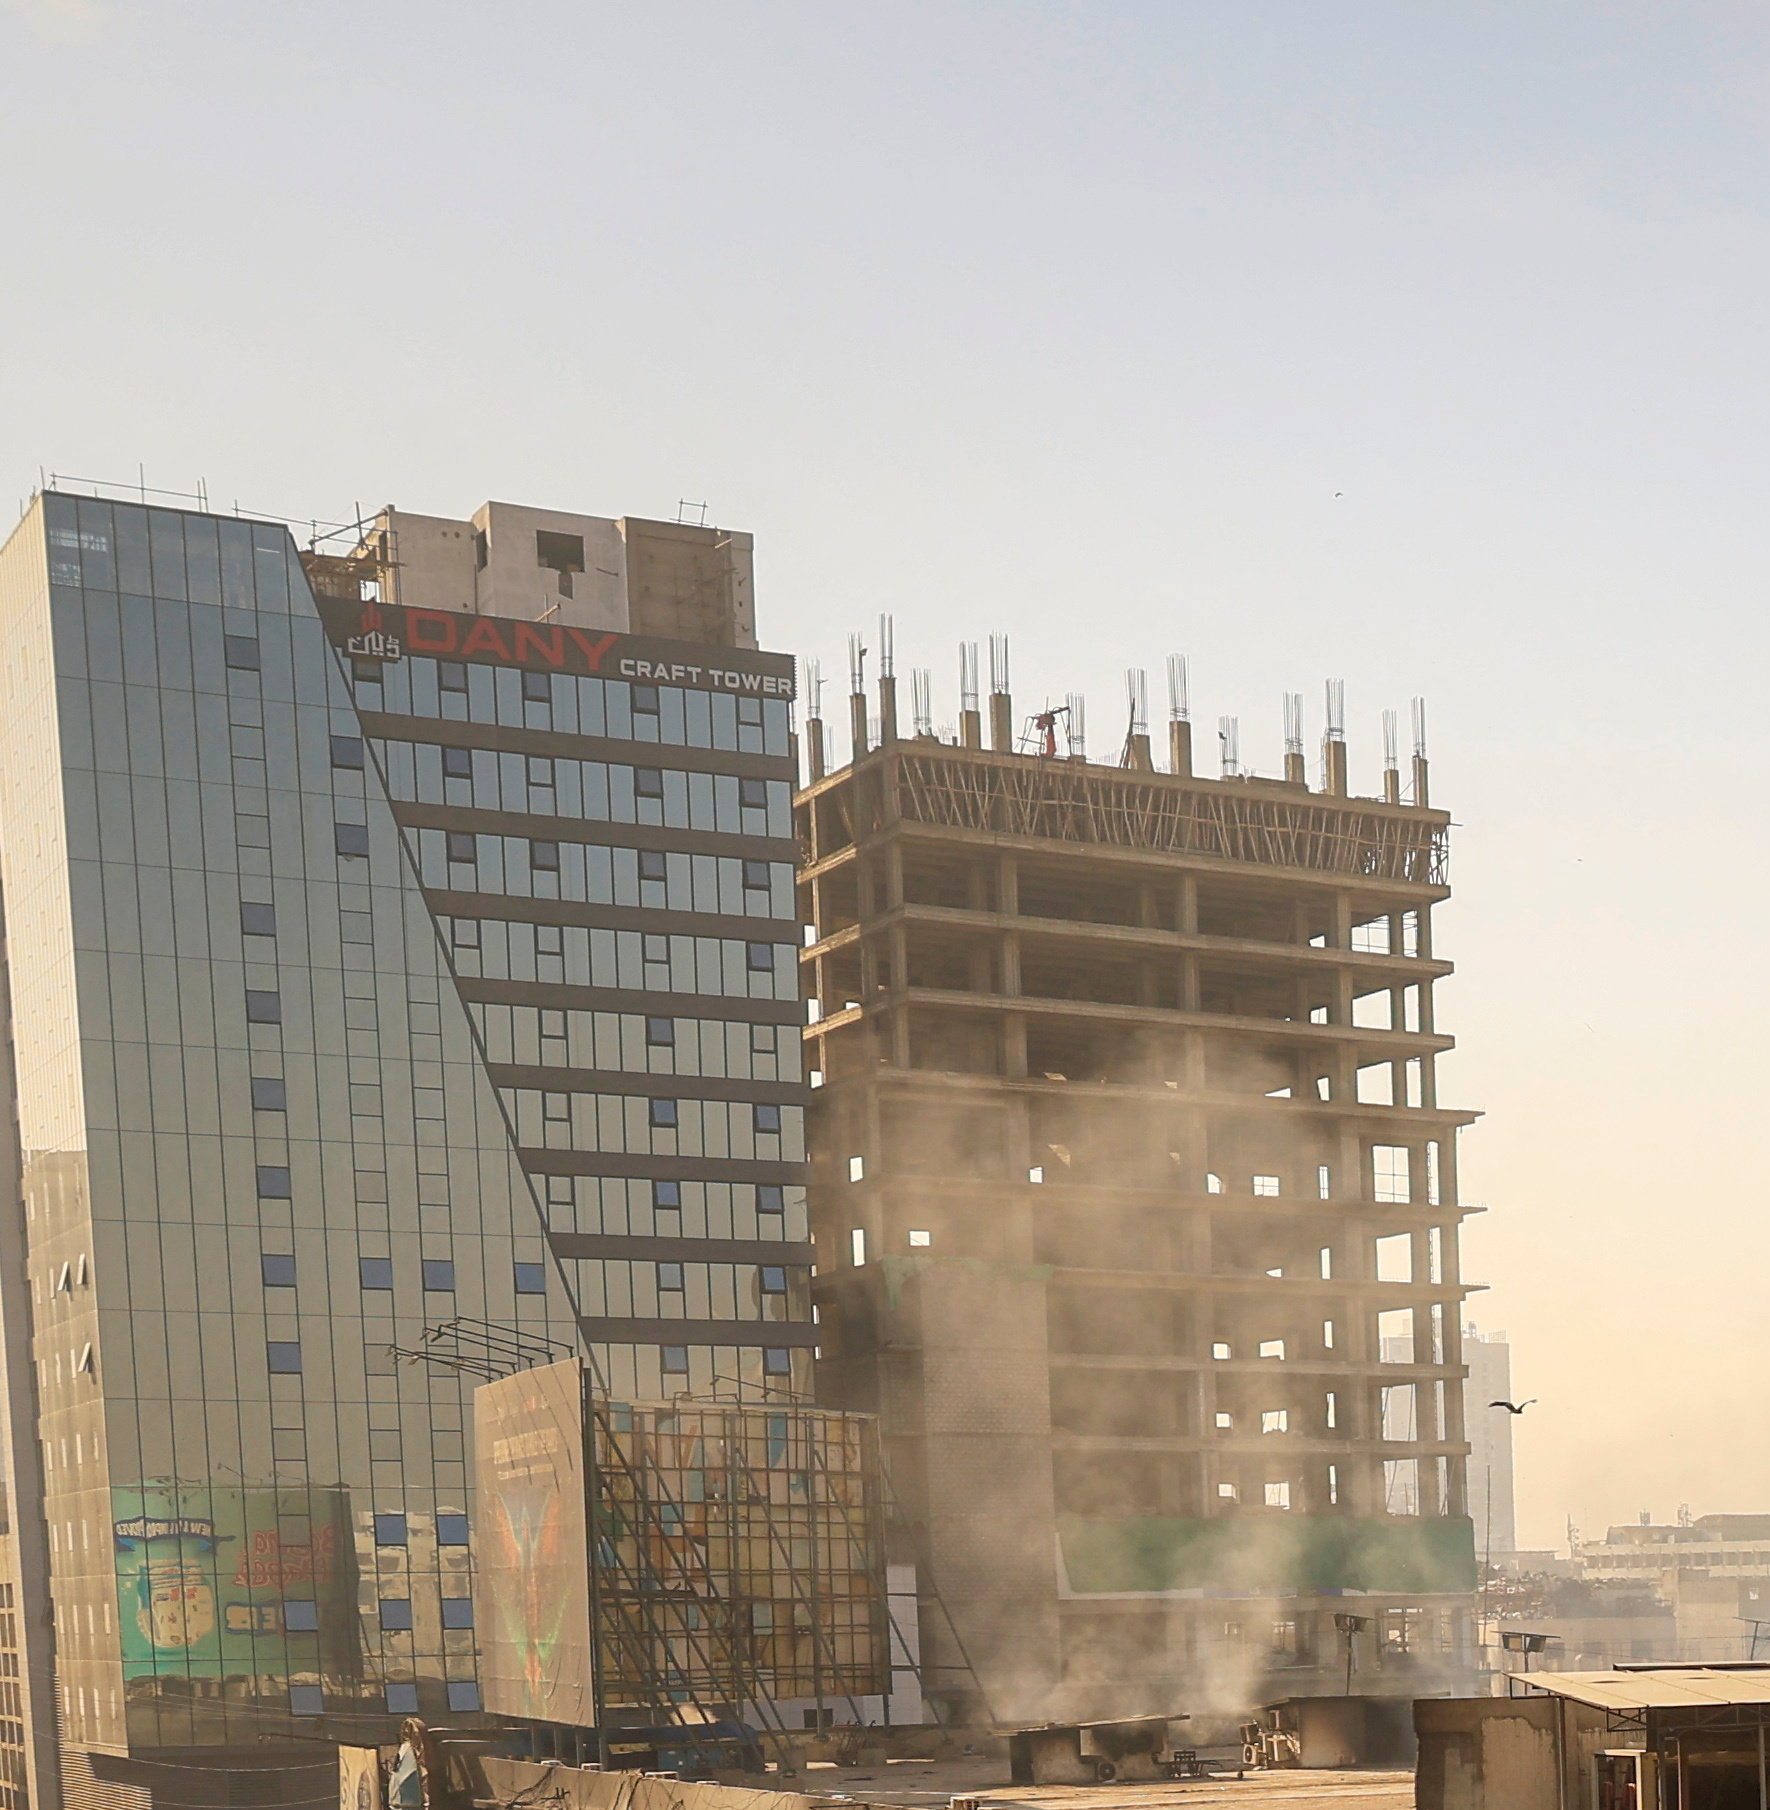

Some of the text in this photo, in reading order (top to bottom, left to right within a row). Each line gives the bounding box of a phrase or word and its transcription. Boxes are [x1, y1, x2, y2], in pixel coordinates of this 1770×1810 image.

[405, 608, 620, 671] DANY
[620, 658, 792, 696] CRAFT TOWER
